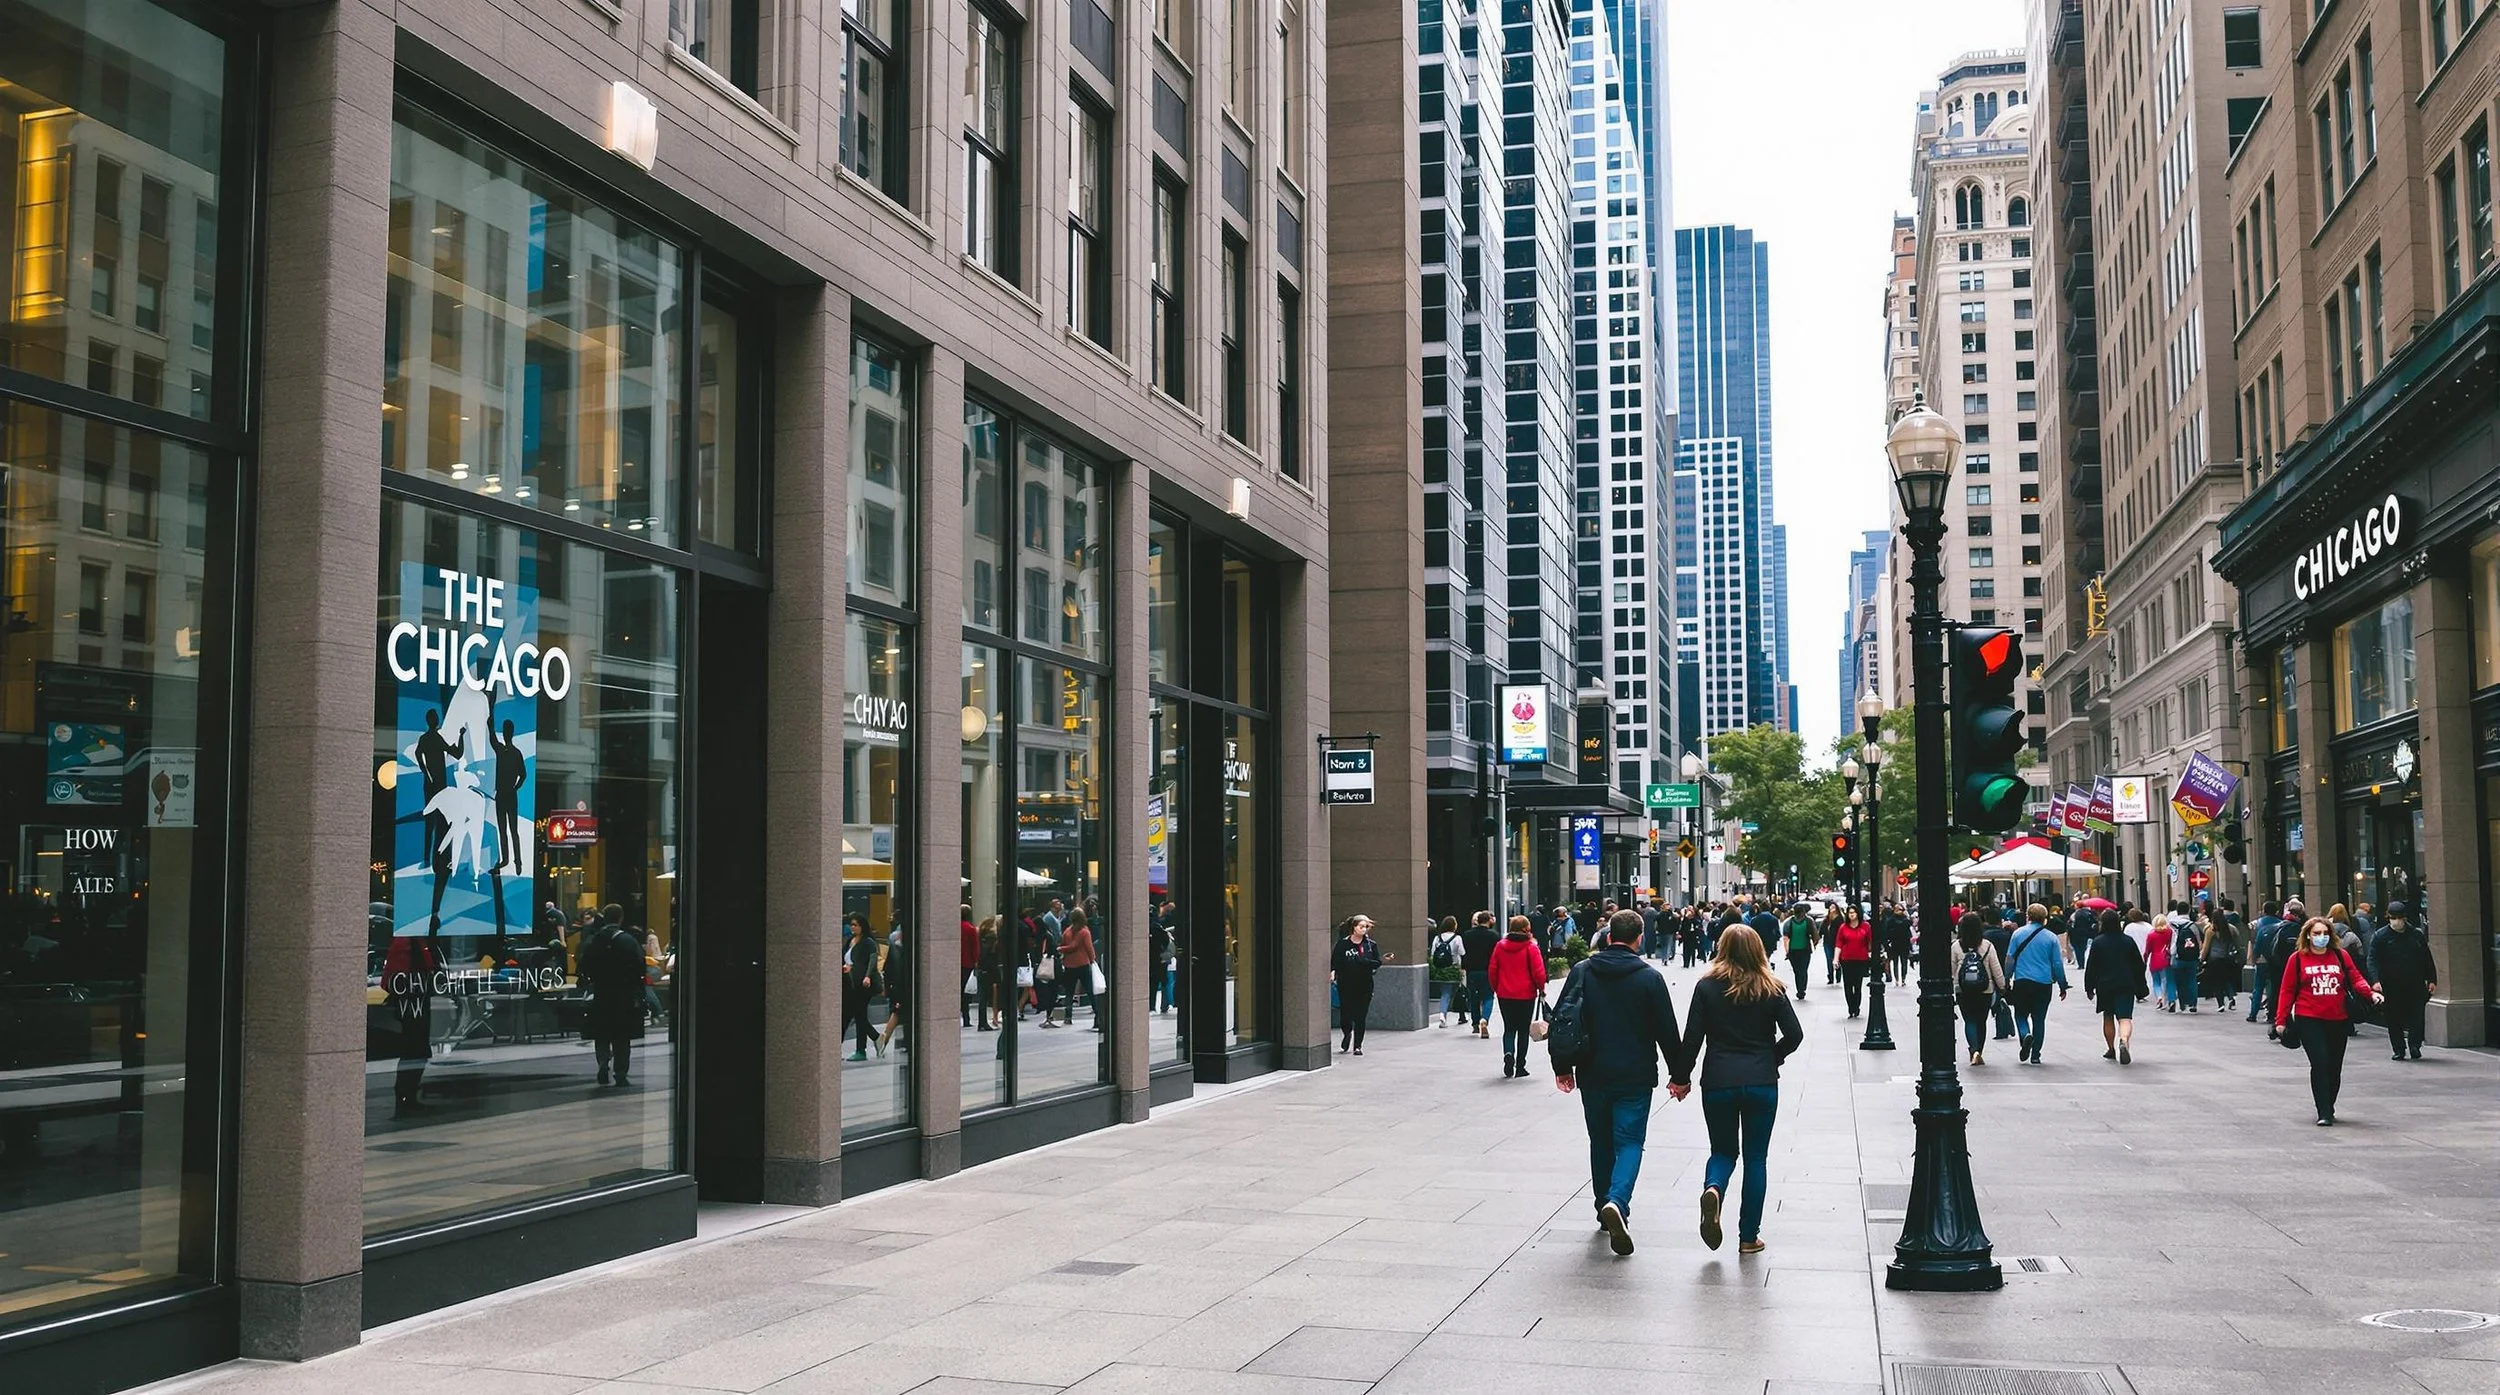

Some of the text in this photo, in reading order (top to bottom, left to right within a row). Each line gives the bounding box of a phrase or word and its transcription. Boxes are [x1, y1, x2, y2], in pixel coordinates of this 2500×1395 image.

[2294, 494, 2400, 600] CHICAGO
[439, 568, 505, 629] THE
[387, 621, 571, 701] CHICAGO
[64, 828, 119, 850] HOW
